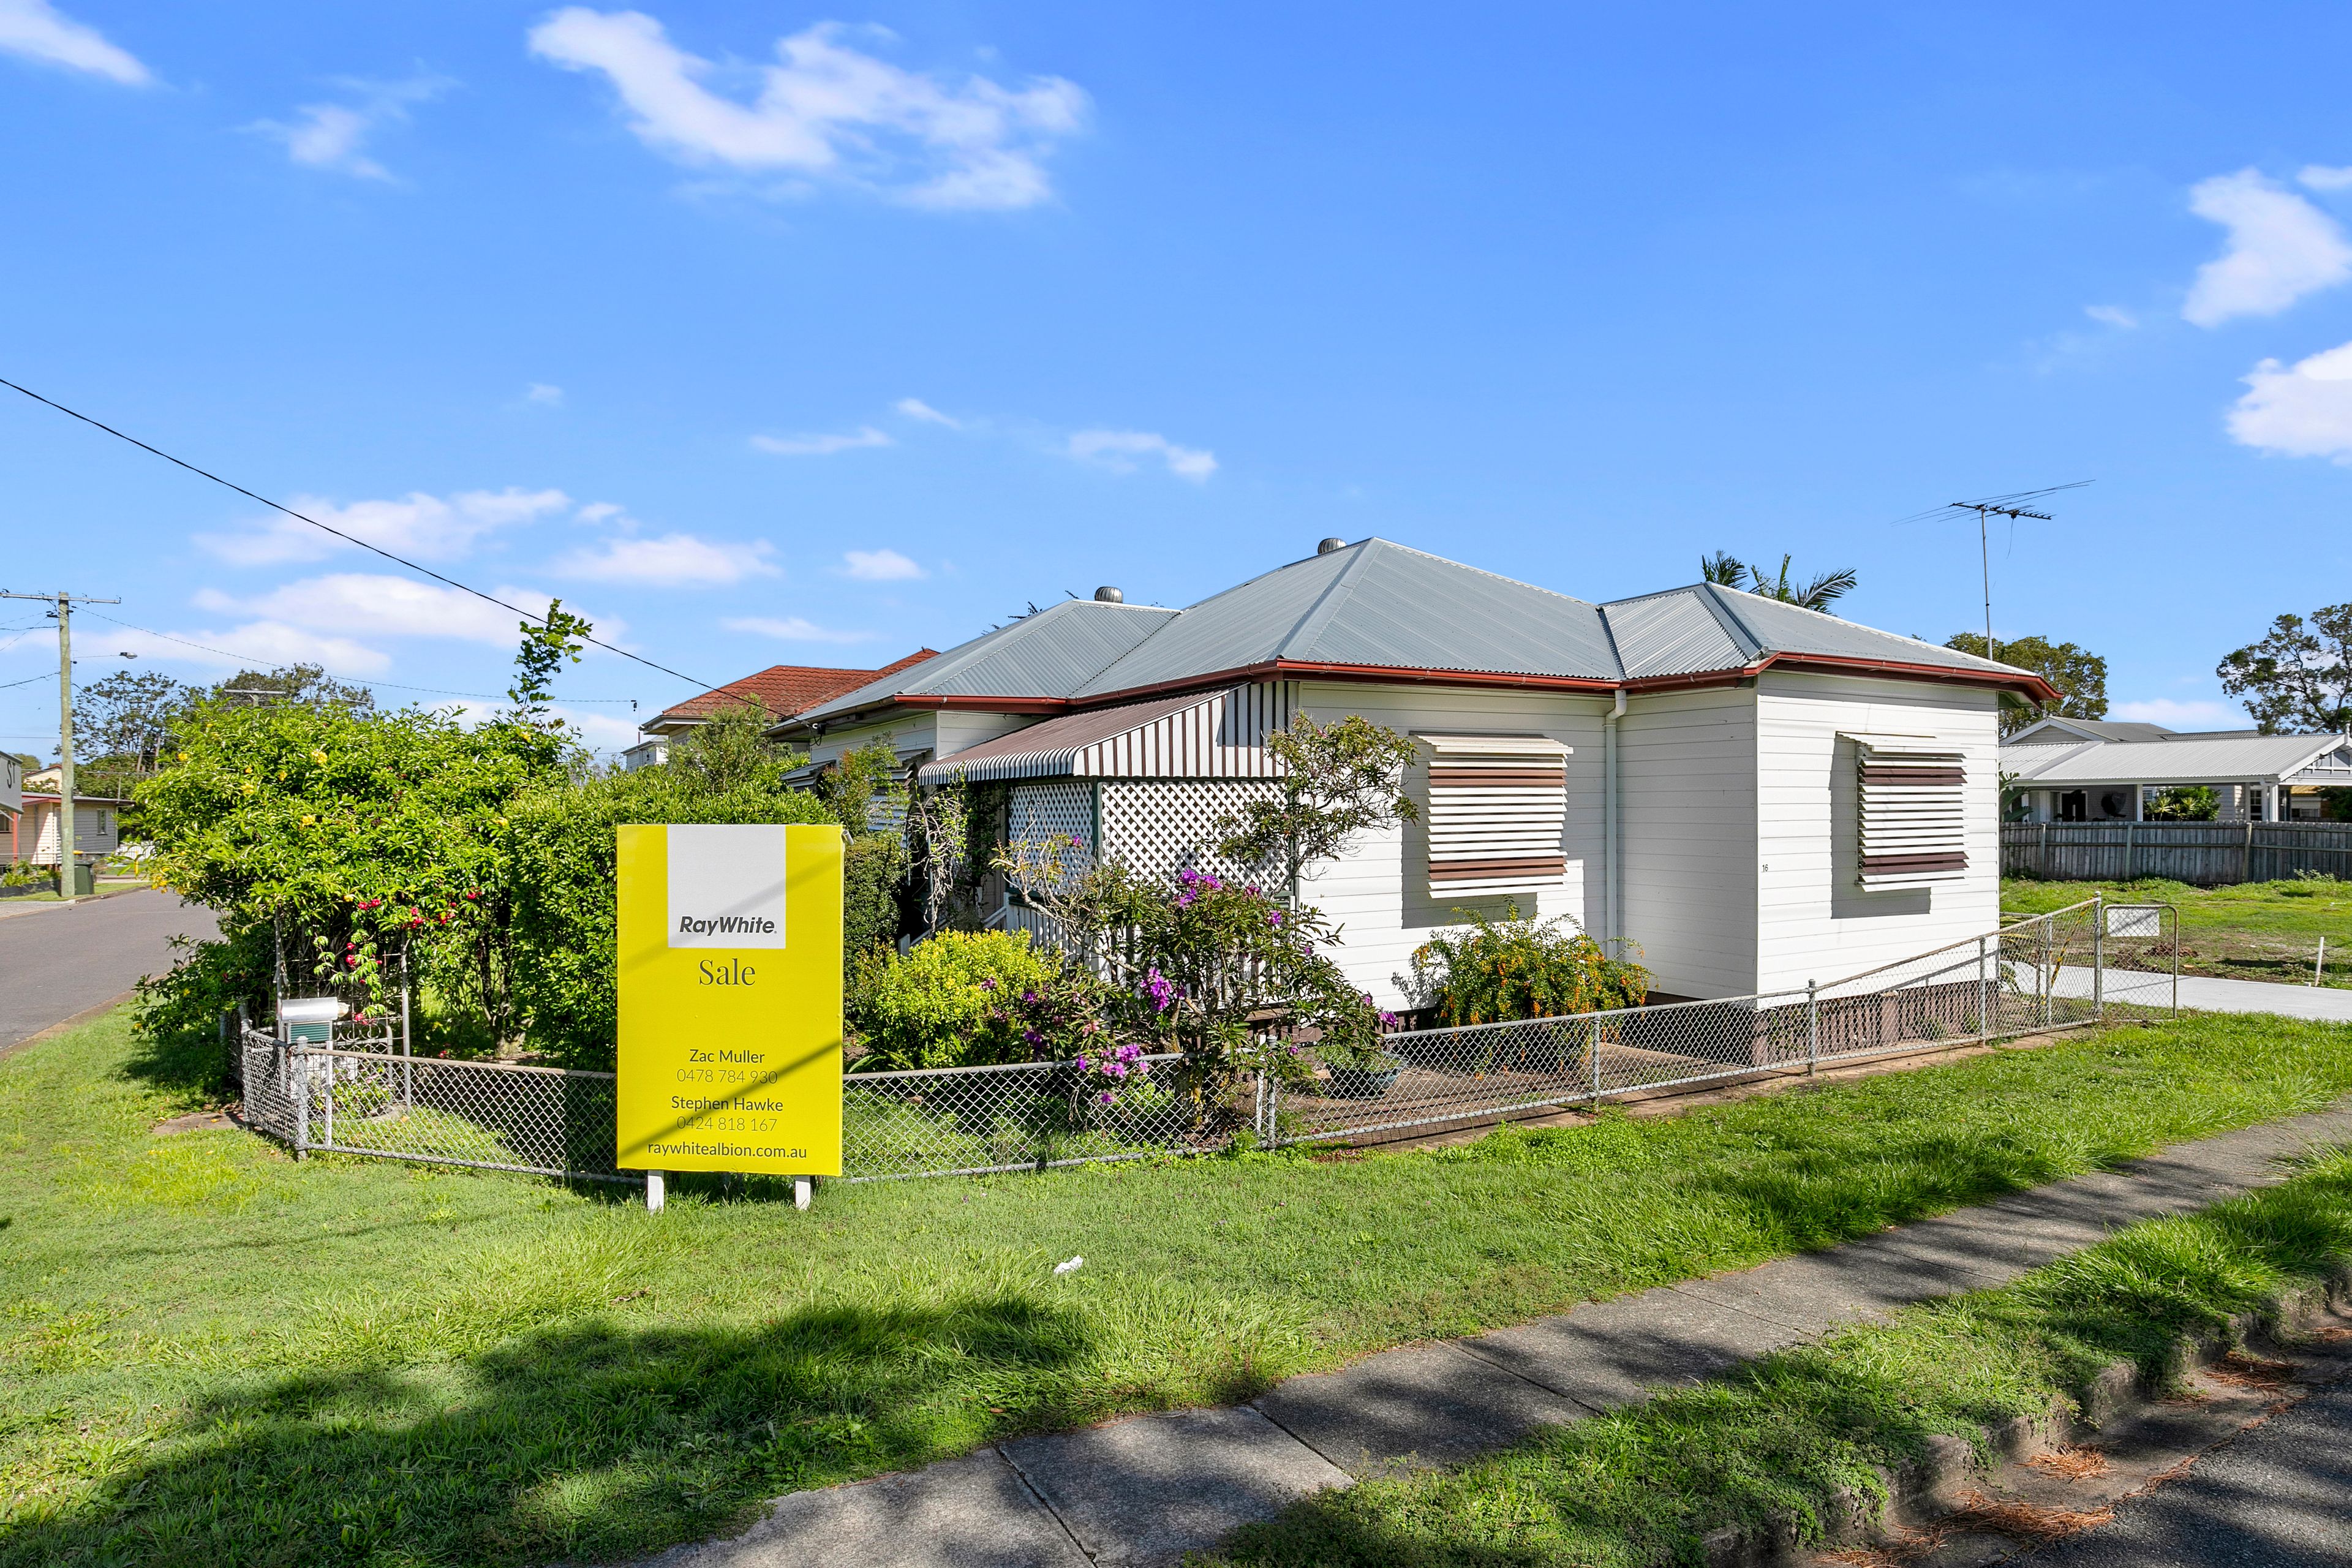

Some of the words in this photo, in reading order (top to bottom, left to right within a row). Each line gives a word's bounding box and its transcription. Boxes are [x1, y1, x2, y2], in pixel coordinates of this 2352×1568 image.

[1762, 864, 1768, 872] 16
[699, 957, 756, 986] Sale
[689, 1049, 715, 1063] Zac
[719, 1049, 765, 1063] Muller
[677, 1068, 713, 1083] 0478
[718, 1069, 745, 1084] 784
[750, 1070, 777, 1084] 930
[671, 1095, 729, 1112] Stephen
[734, 1097, 783, 1112] Hawke
[677, 1116, 713, 1130] 0424
[718, 1117, 745, 1131] 818
[751, 1118, 777, 1132] 167
[647, 1142, 807, 1158] raywhitealbion.com.au
